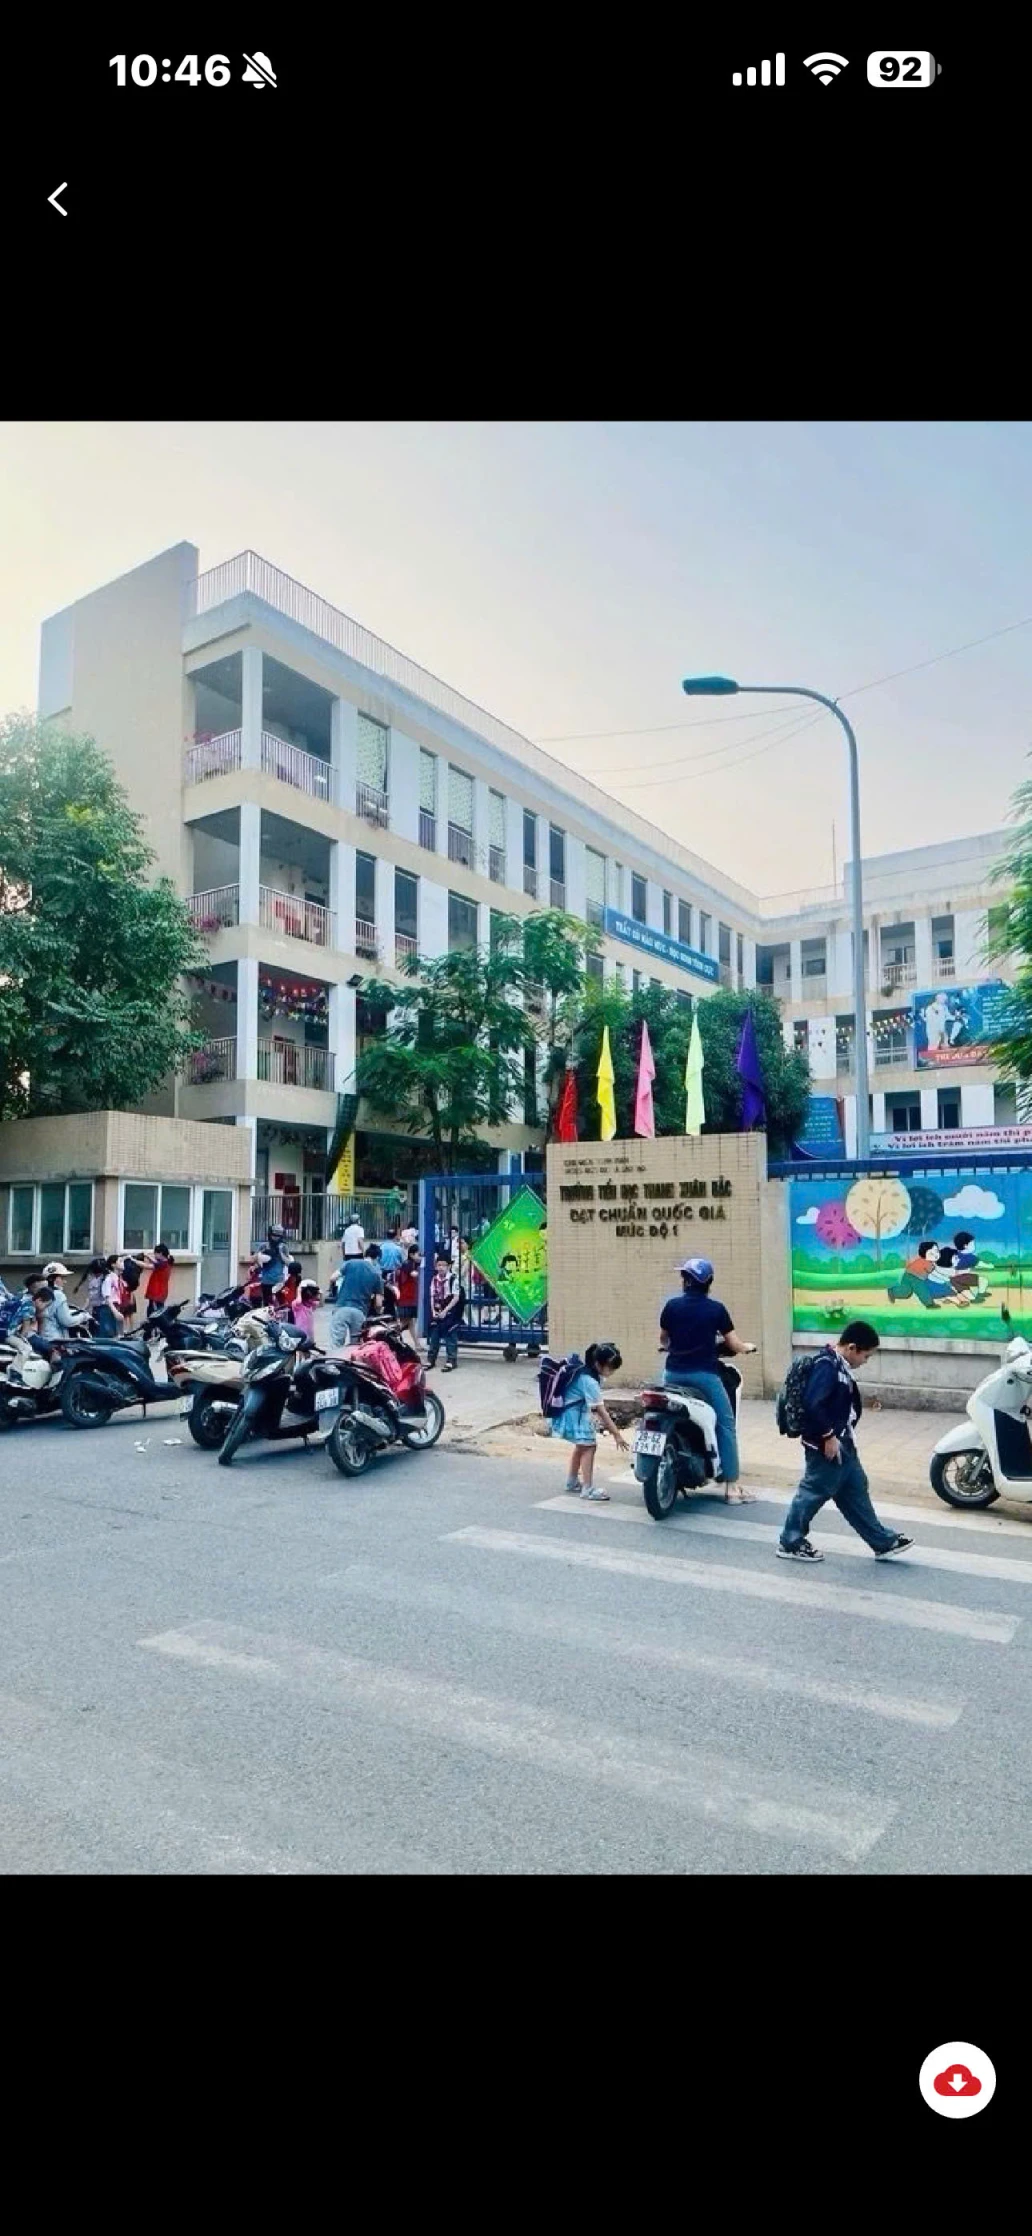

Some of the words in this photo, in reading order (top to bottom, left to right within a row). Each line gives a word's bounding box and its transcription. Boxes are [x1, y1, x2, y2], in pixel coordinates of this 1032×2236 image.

[599, 1202, 647, 1222] CHUẨN
[652, 1202, 692, 1221] QUỐC
[699, 1205, 726, 1221] GIA
